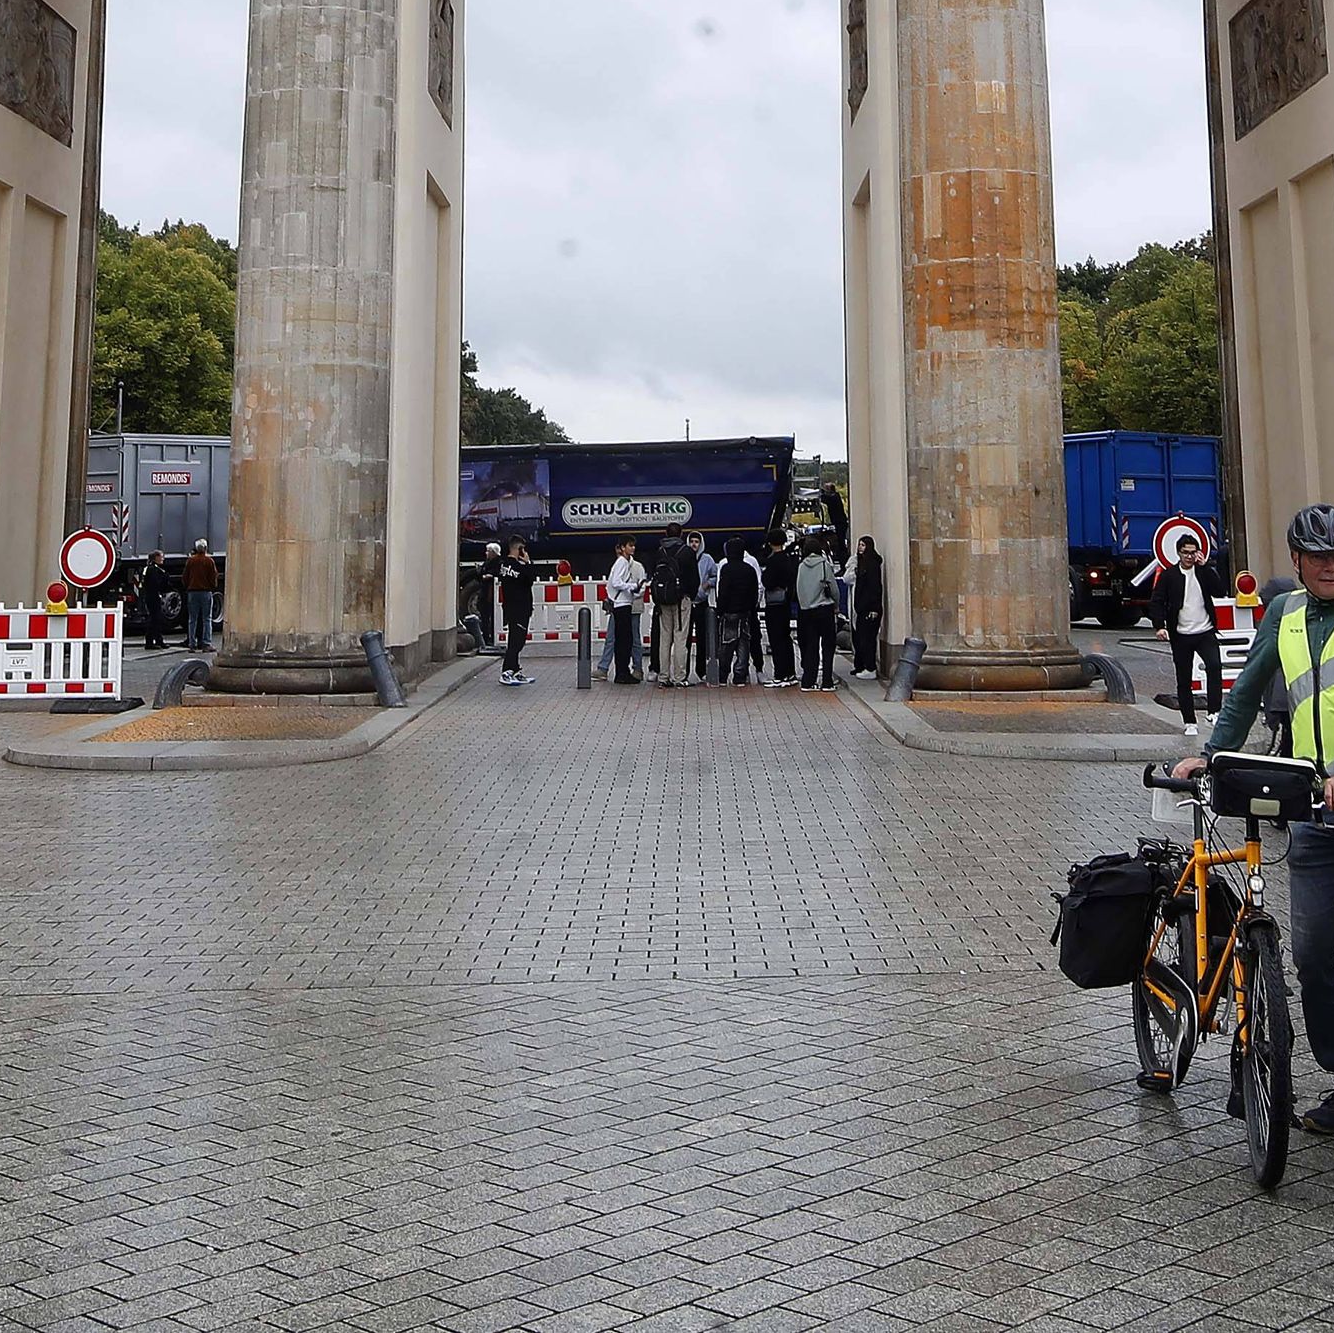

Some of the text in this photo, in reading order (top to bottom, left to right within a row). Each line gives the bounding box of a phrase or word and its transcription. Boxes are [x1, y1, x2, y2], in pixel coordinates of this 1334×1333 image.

[152, 473, 188, 484] REMONDIS
[86, 484, 110, 492] EMONDIS
[570, 498, 686, 515] SCHUSTER KG
